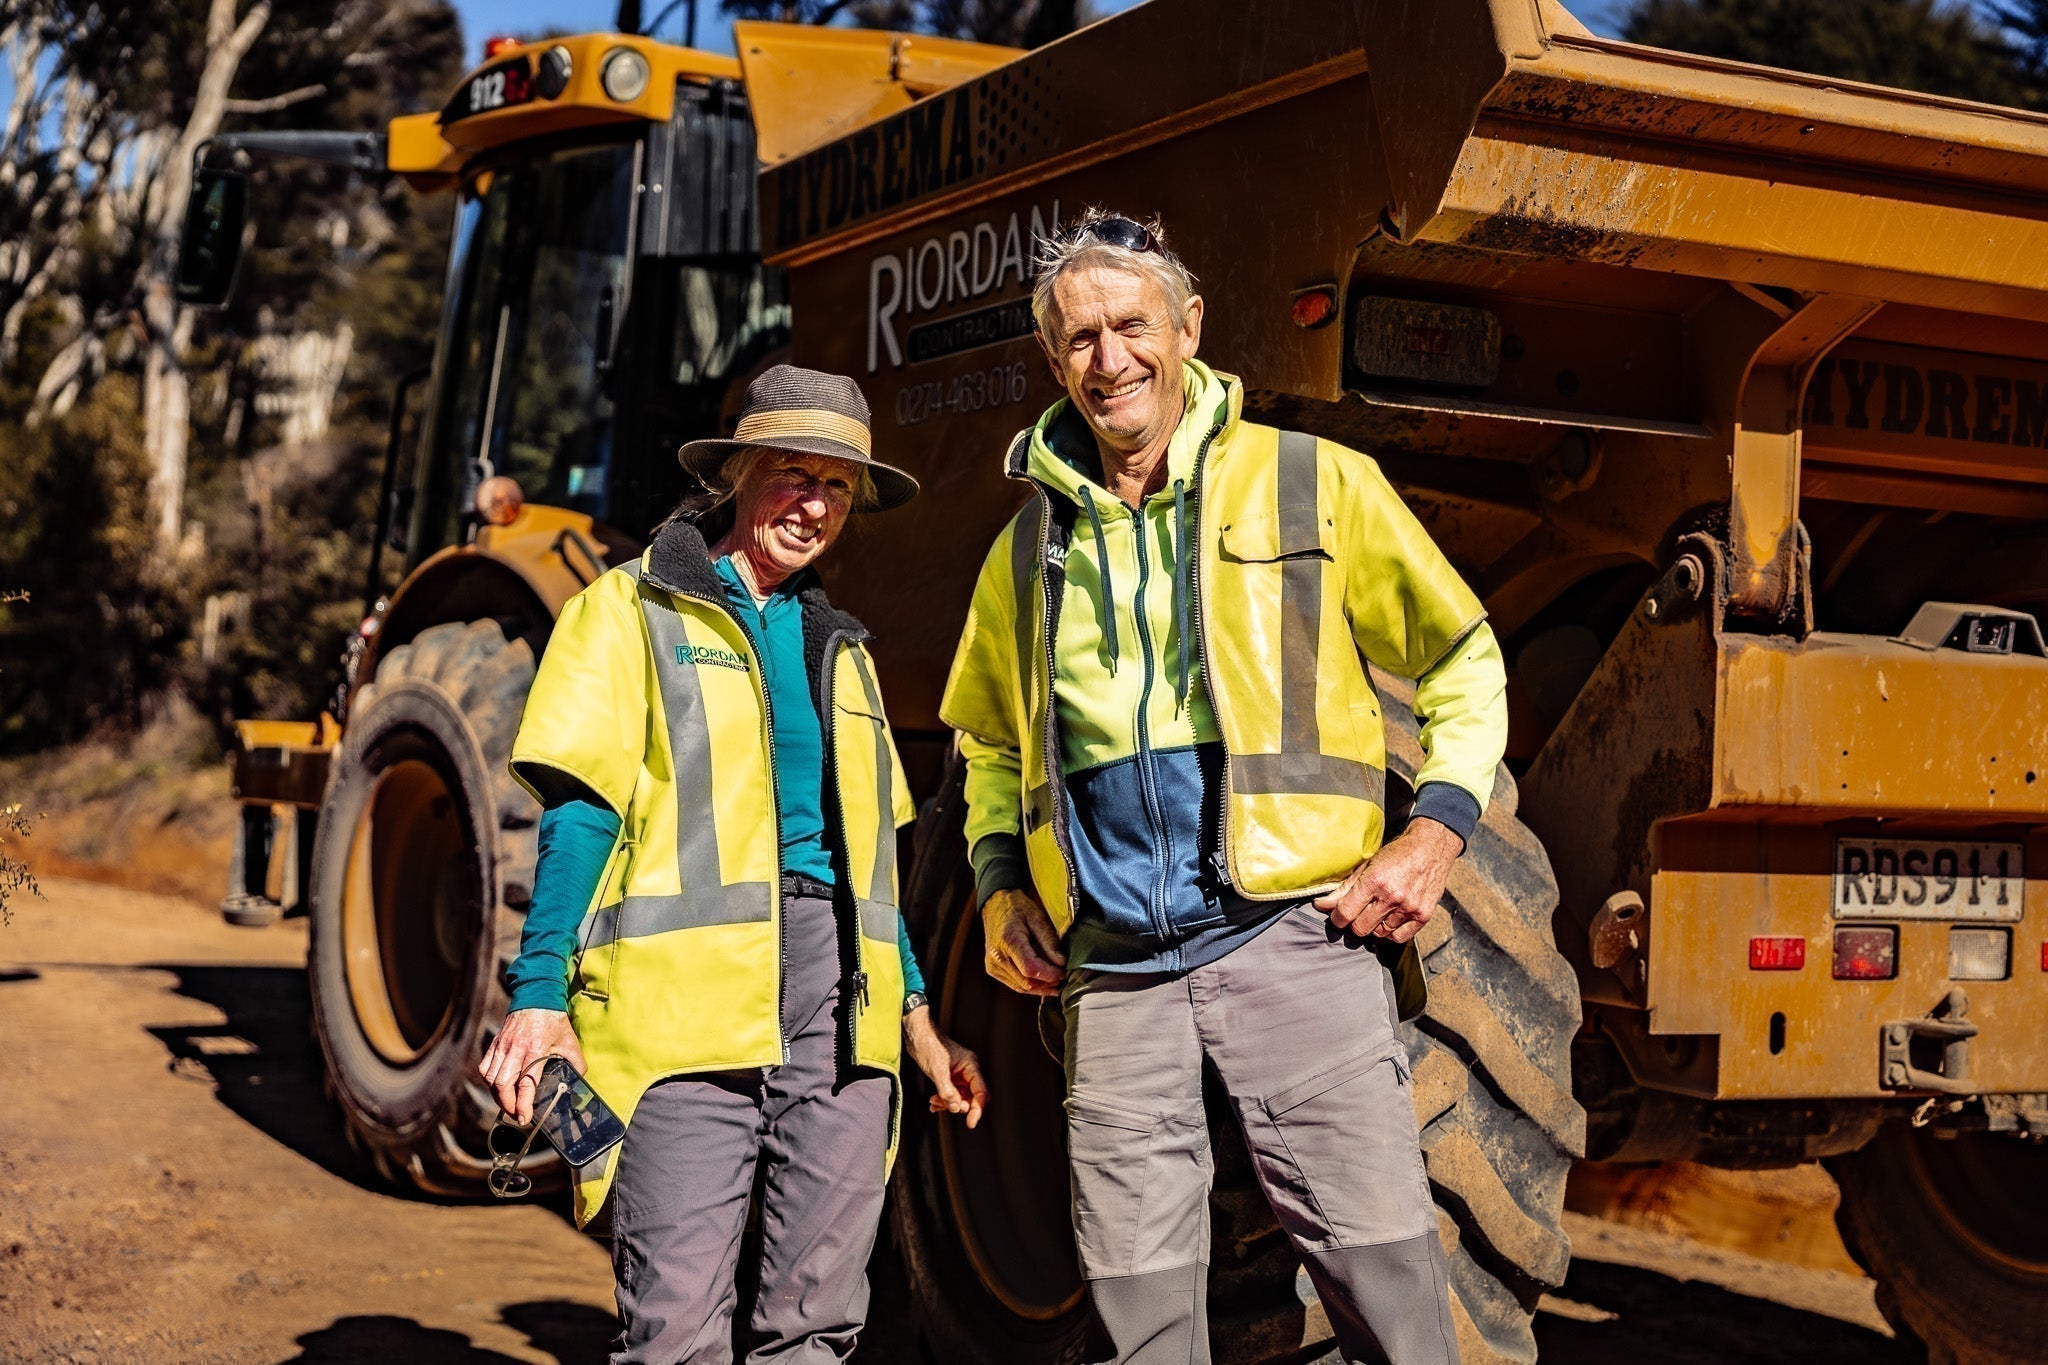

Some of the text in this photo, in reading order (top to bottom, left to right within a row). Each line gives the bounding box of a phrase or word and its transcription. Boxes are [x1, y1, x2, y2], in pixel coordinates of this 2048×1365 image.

[469, 71, 505, 112] 912
[777, 87, 973, 248] HYDREMA
[916, 302, 1033, 355] CONTRACTIN
[675, 645, 749, 665] RIORDAN
[1842, 847, 2009, 906] RDS911
